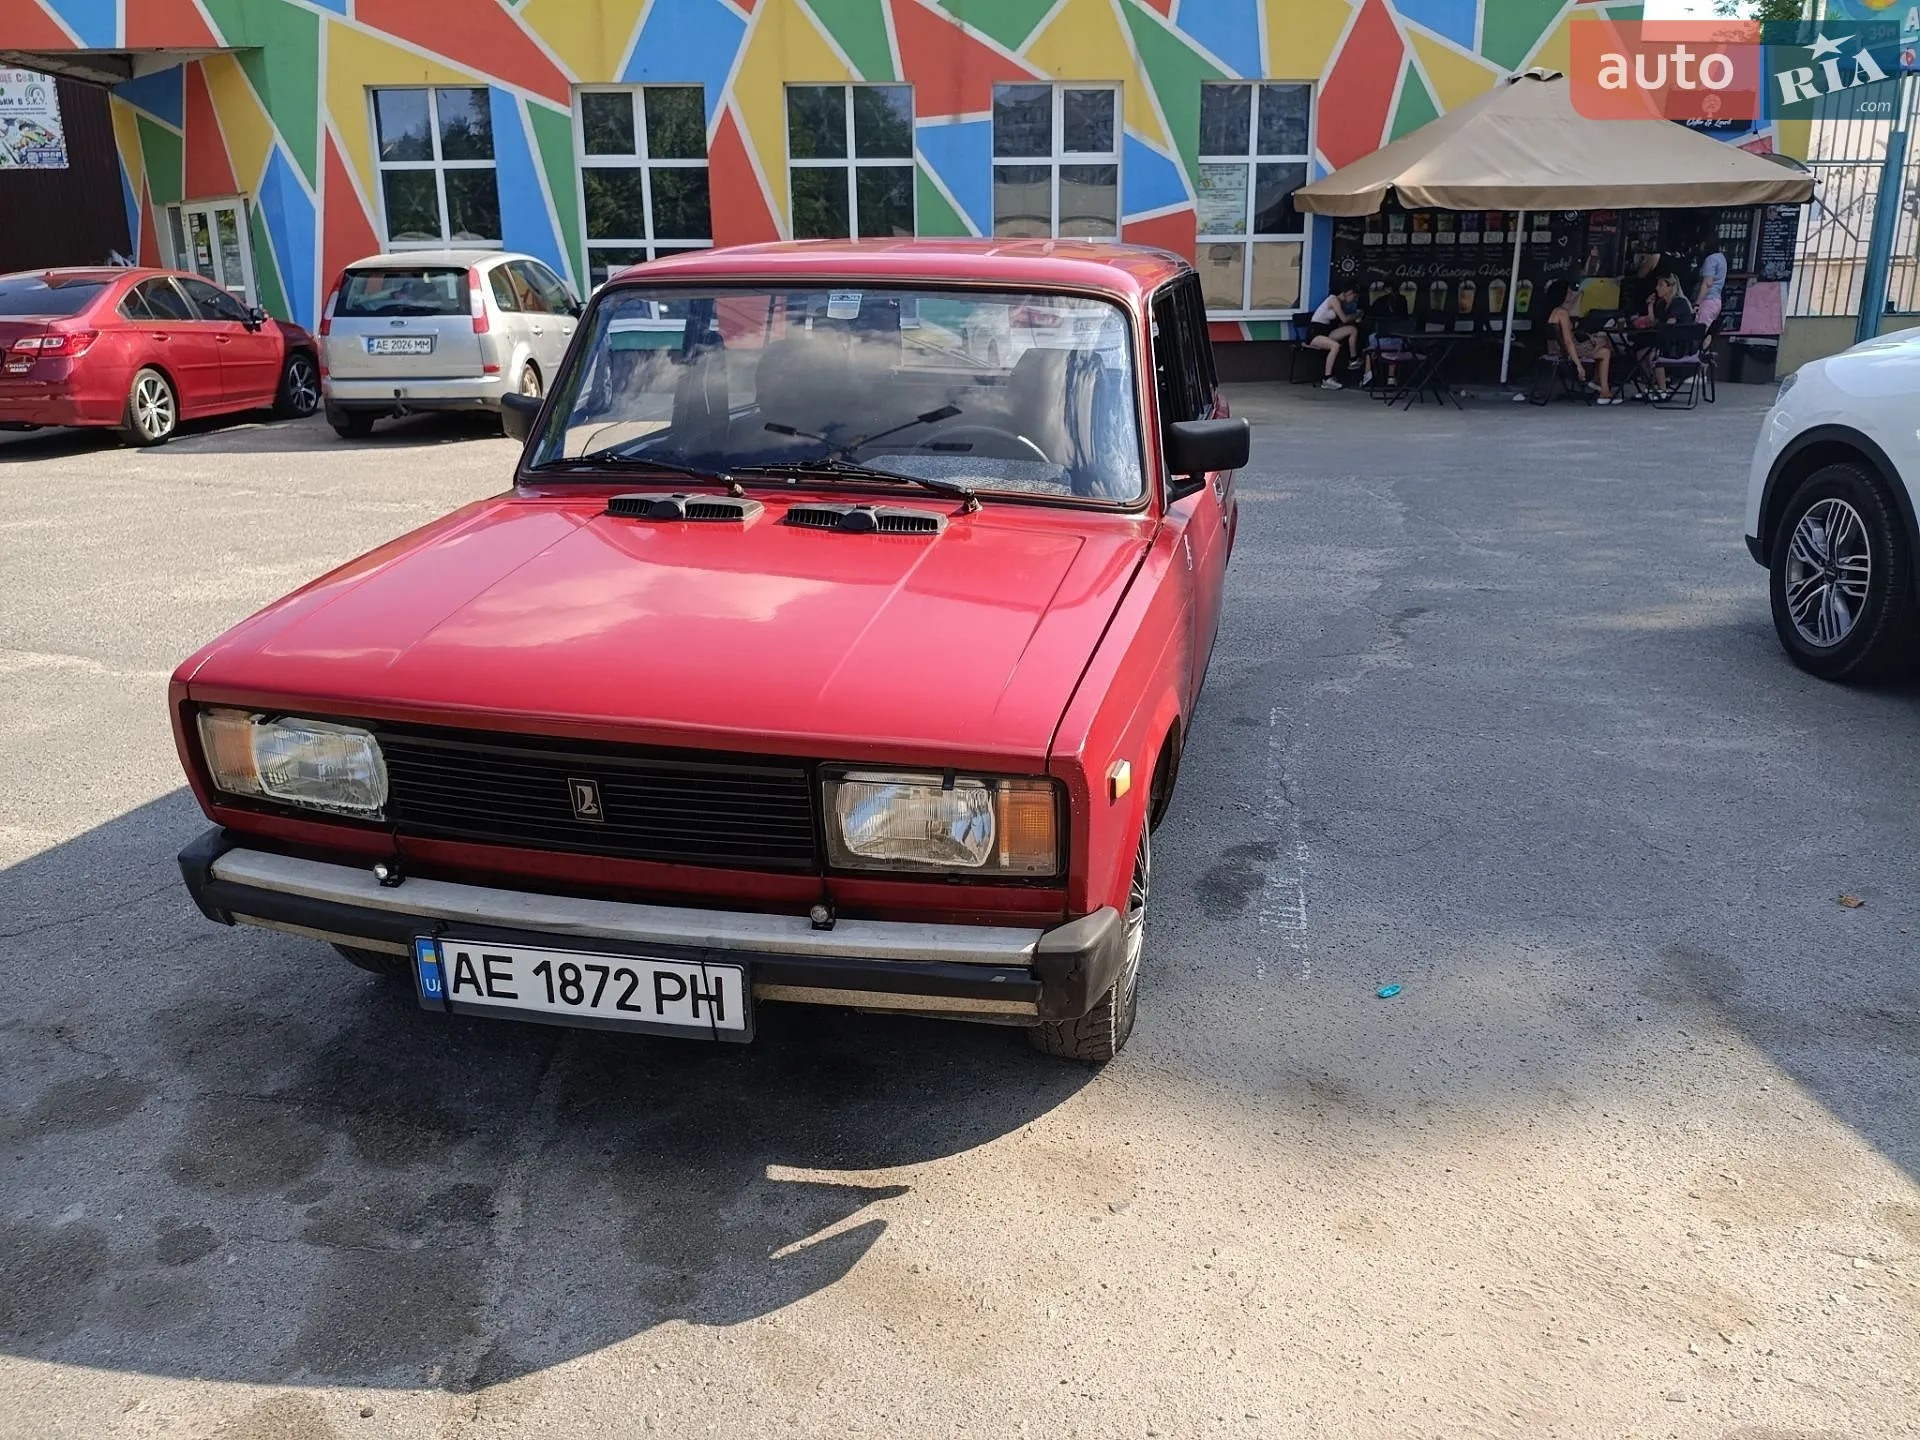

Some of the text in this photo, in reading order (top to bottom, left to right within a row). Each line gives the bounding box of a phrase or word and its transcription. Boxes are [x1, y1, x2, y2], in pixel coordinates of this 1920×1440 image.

[376, 339, 389, 350] AE
[391, 339, 413, 350] 2026
[414, 340, 430, 350] MM
[452, 952, 725, 1021] AE 1872 PH
